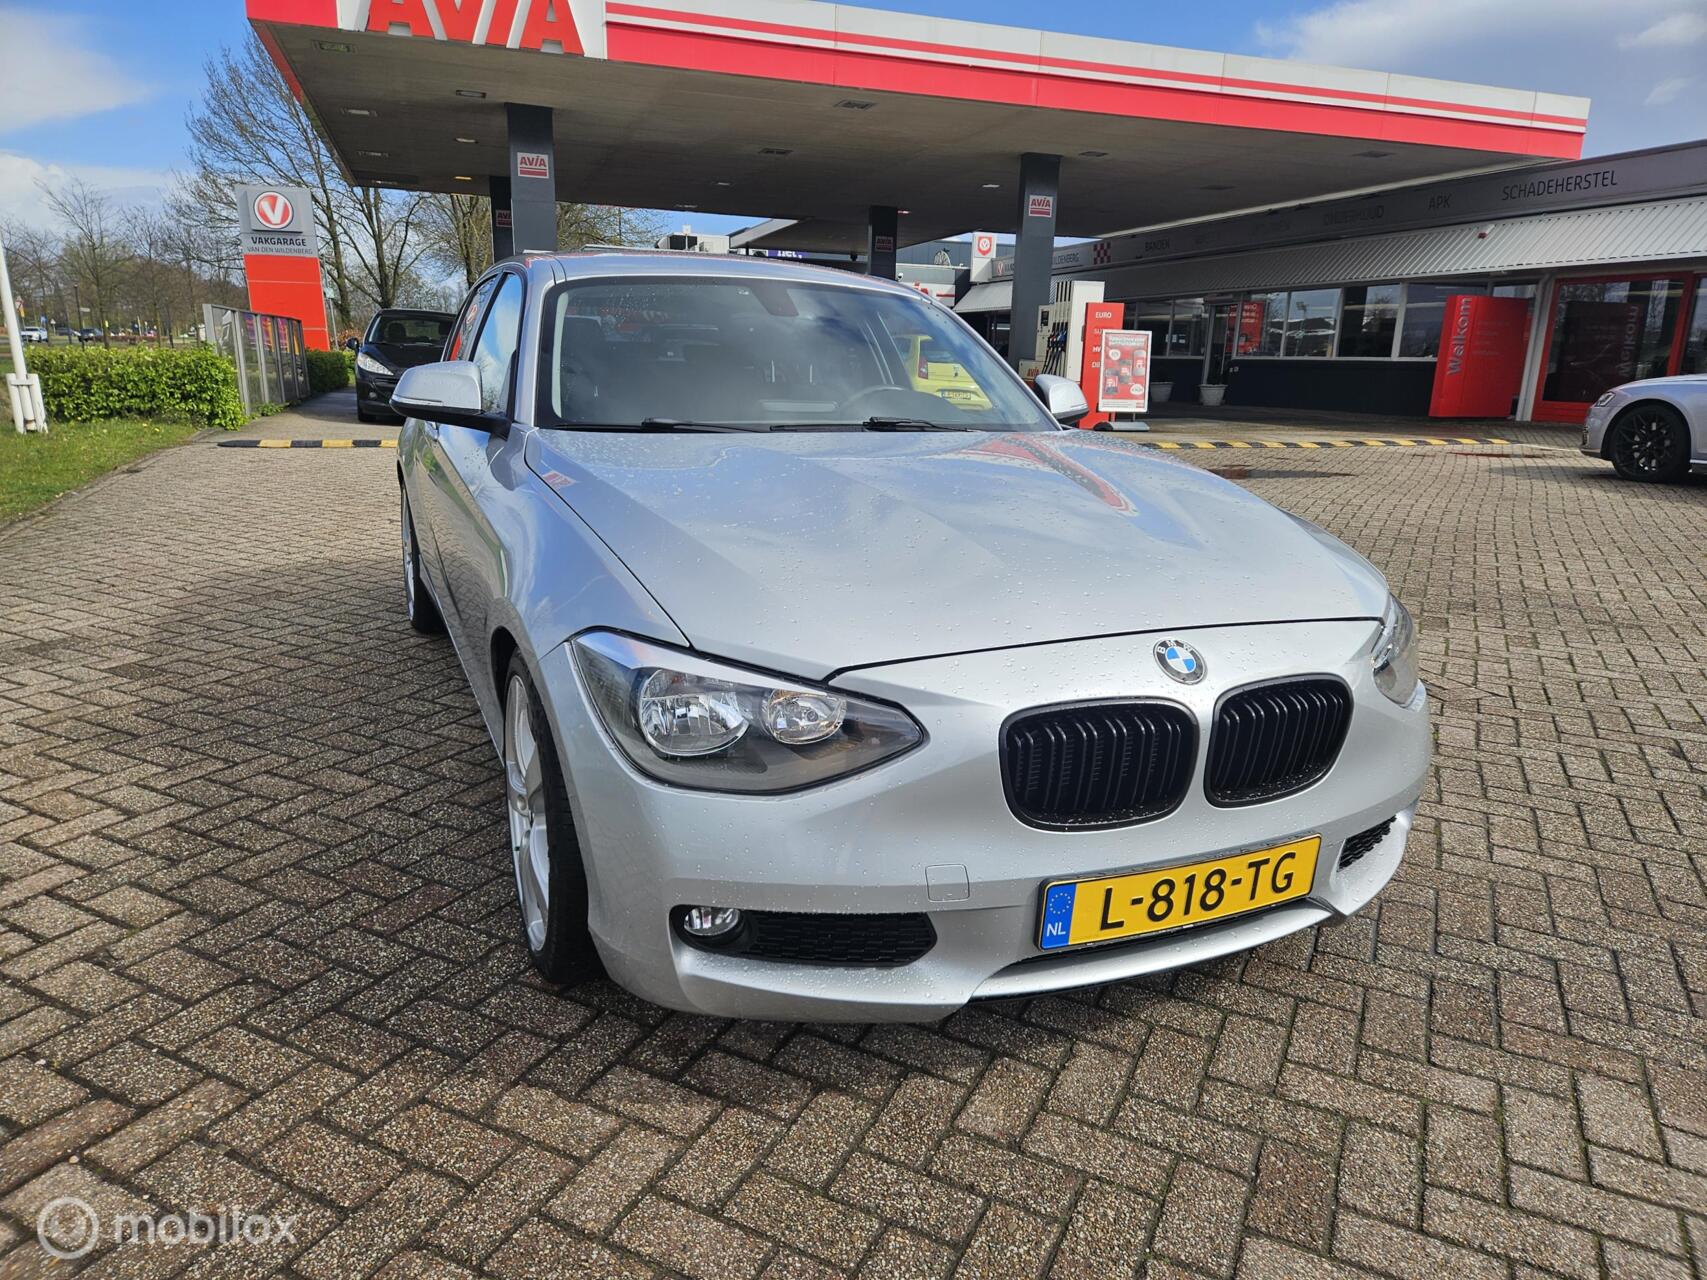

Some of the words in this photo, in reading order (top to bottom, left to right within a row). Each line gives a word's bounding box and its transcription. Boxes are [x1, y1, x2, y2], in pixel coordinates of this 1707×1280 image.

[1501, 170, 1618, 201] SCHADEHERSTEL
[1428, 195, 1451, 210] APK
[251, 236, 307, 247] VAKGARAGE
[274, 246, 313, 255] WILDENBERG
[1095, 311, 1112, 319] EURO
[1447, 297, 1474, 376] Welkom
[1099, 851, 1297, 932] L-818-TG
[1046, 921, 1067, 937] NL
